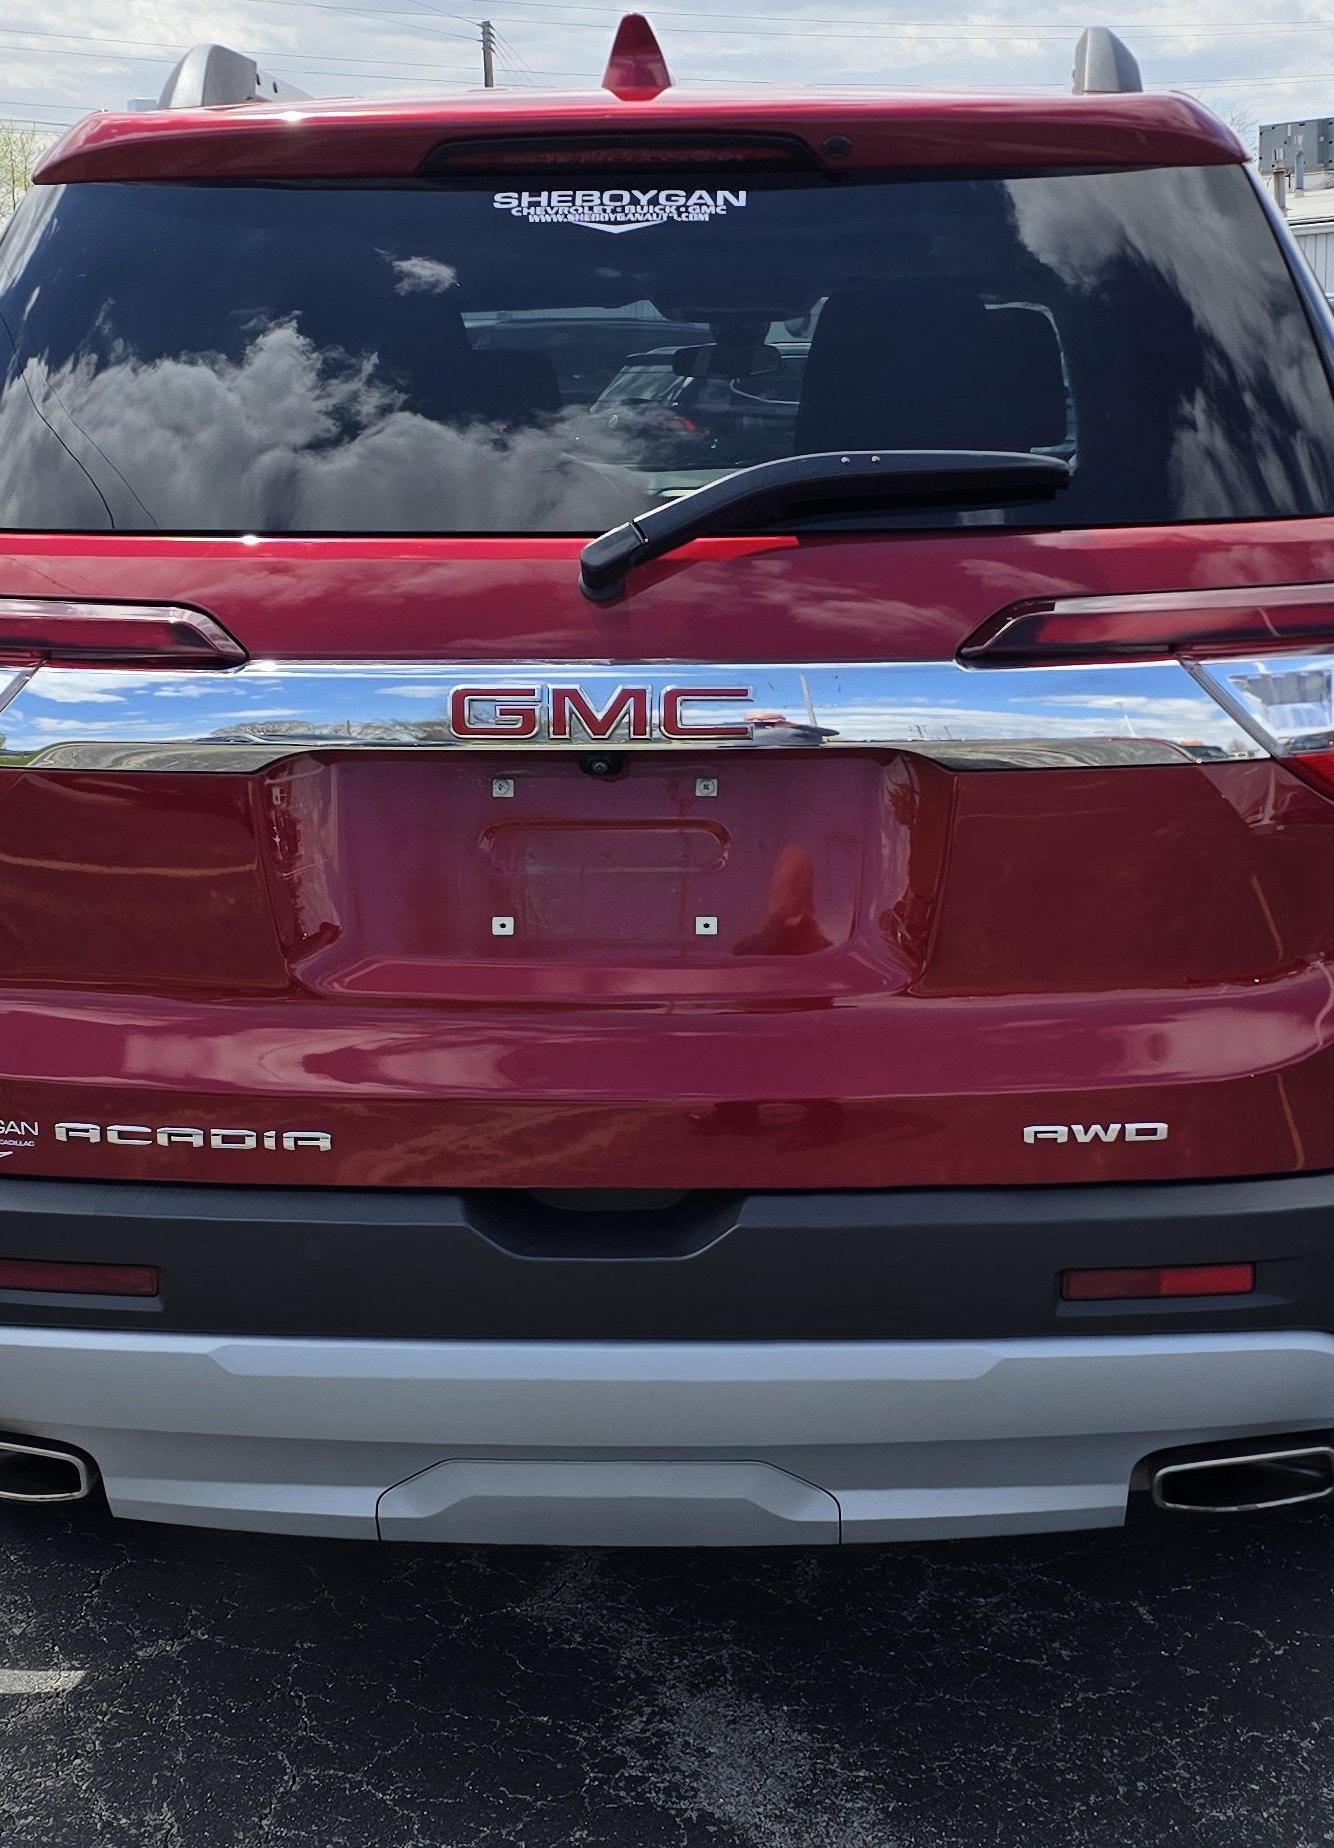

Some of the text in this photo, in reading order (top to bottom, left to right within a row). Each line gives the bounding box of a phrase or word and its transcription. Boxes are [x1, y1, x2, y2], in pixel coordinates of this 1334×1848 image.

[493, 190, 747, 209] SHEBOYGAN
[688, 205, 728, 215] GMC
[447, 682, 754, 741] GMC
[54, 1122, 332, 1151] ACADIA
[1023, 1122, 1169, 1144] AWD
